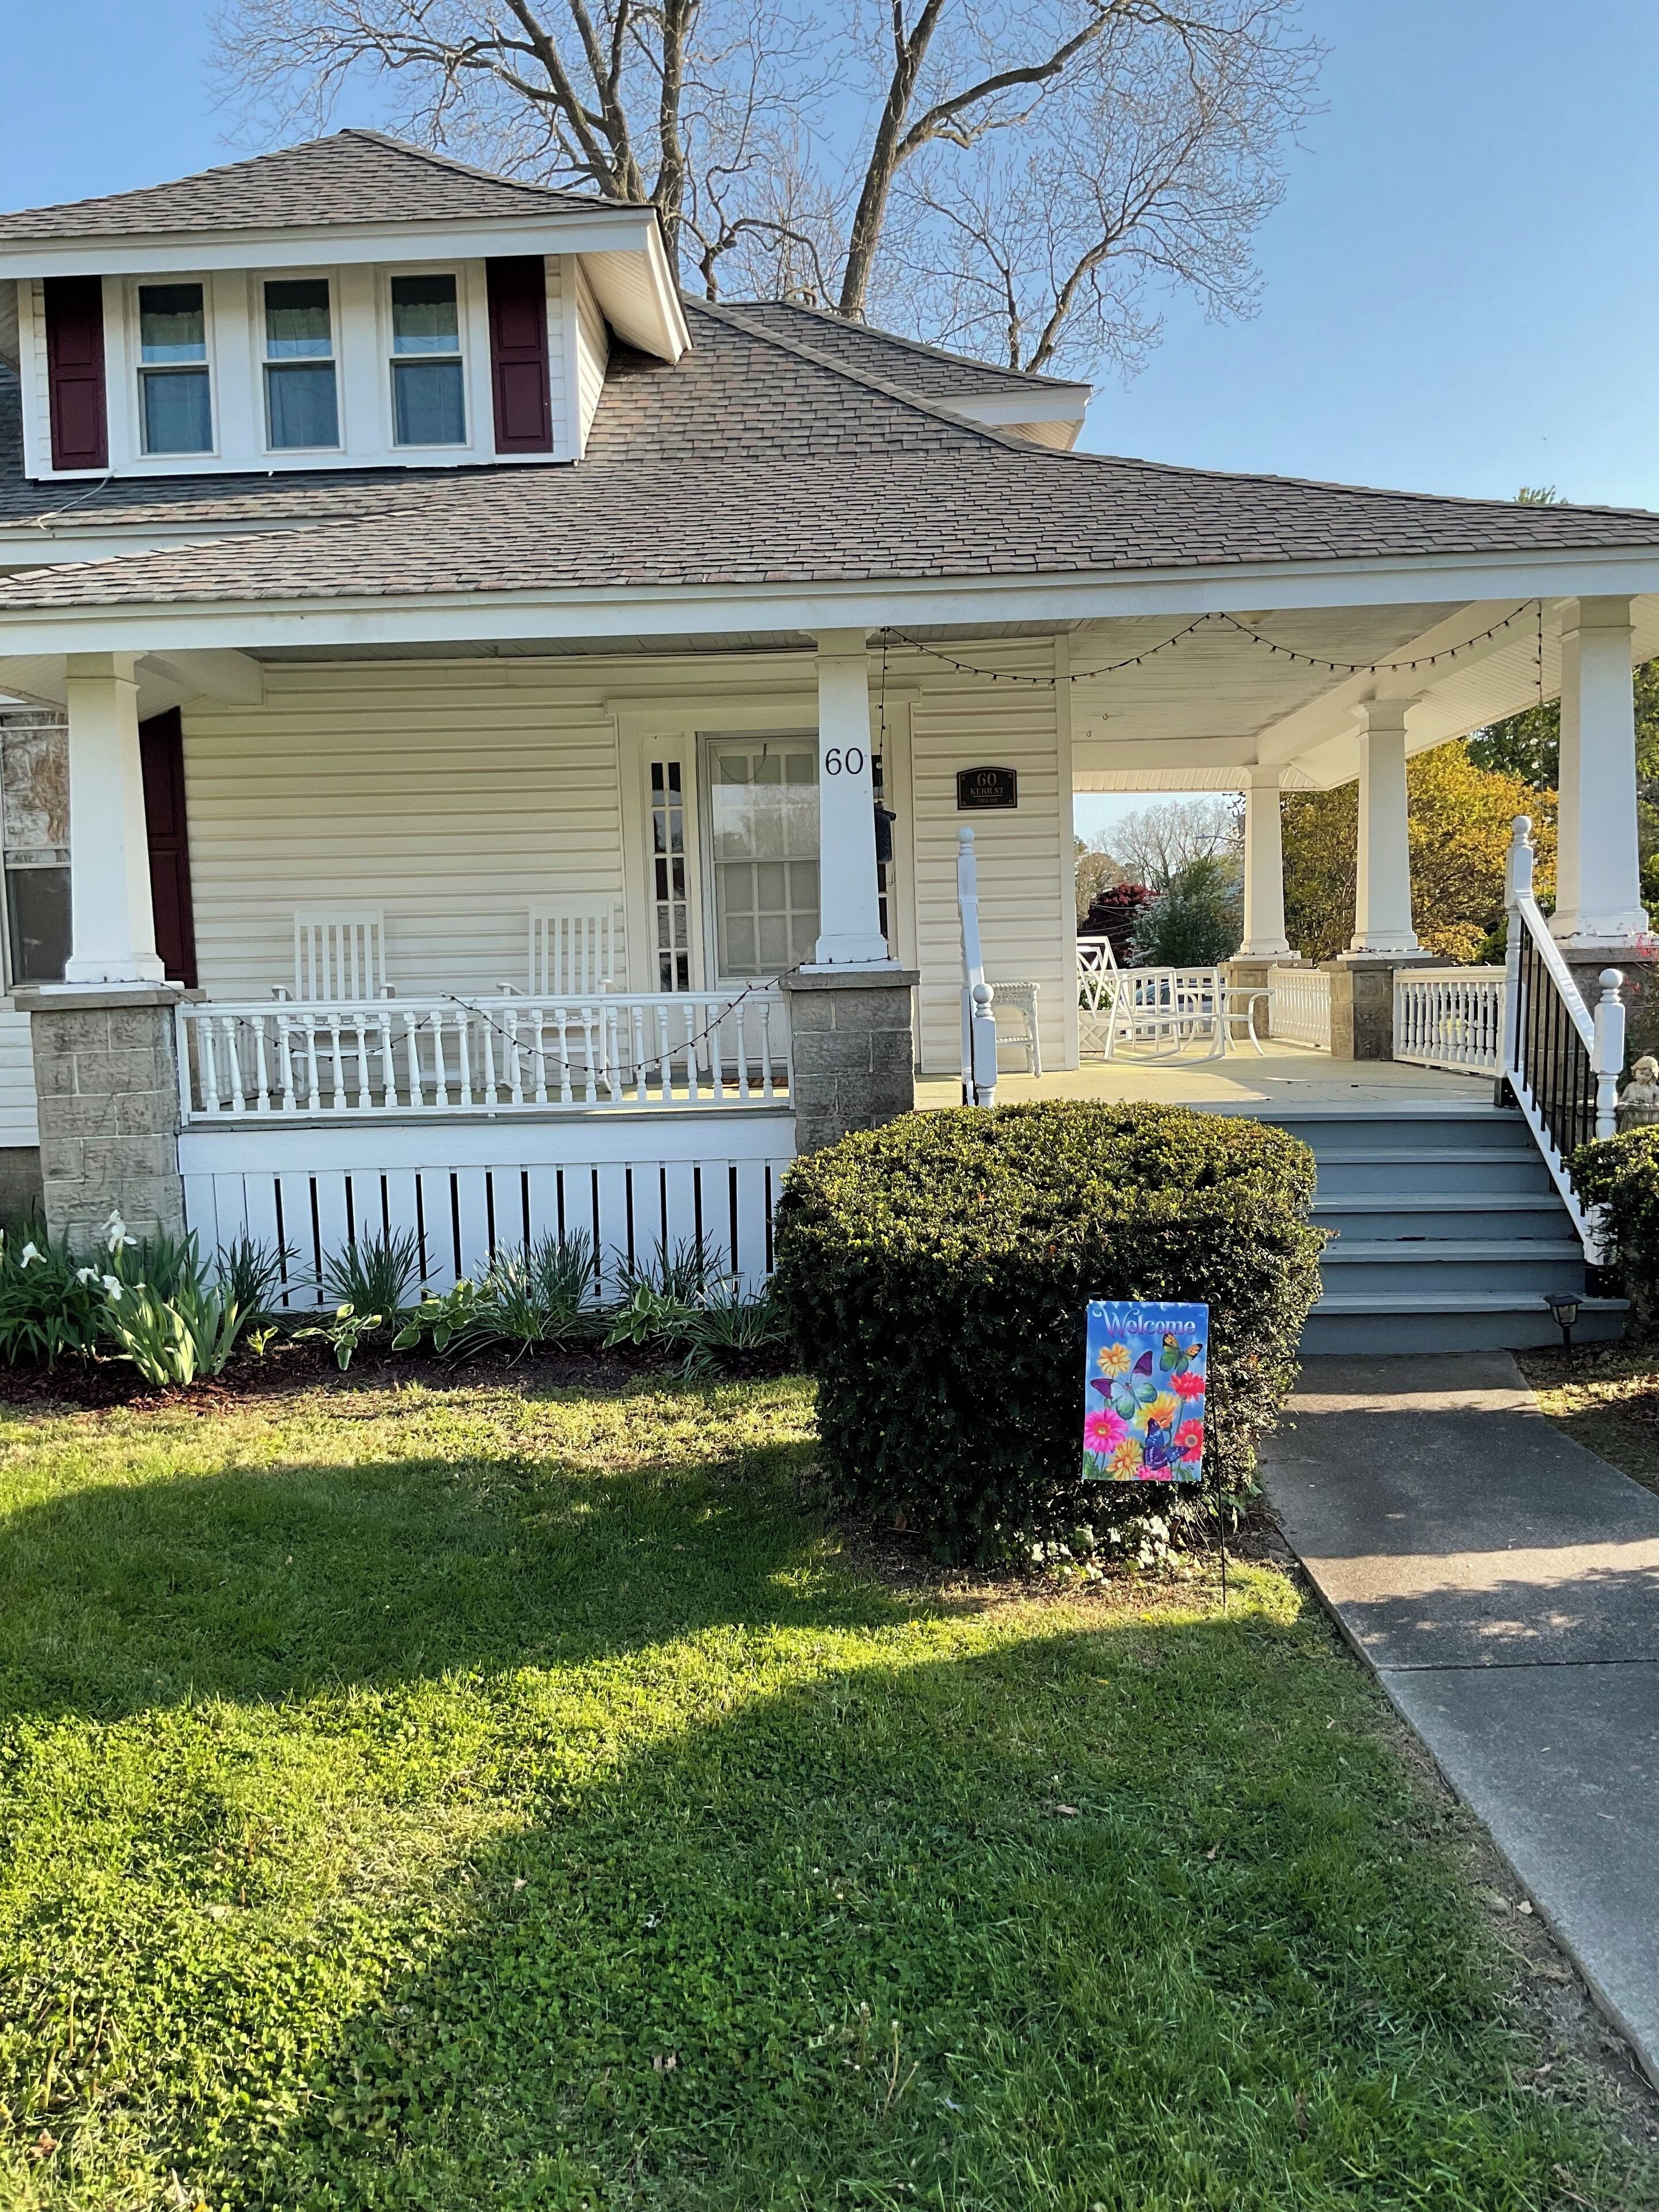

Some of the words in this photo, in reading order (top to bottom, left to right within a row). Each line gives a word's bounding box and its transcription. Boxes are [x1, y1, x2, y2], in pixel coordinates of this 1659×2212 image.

[825, 748, 863, 775] 60
[976, 772, 997, 787] 60
[1092, 1307, 1196, 1338] Welcome
